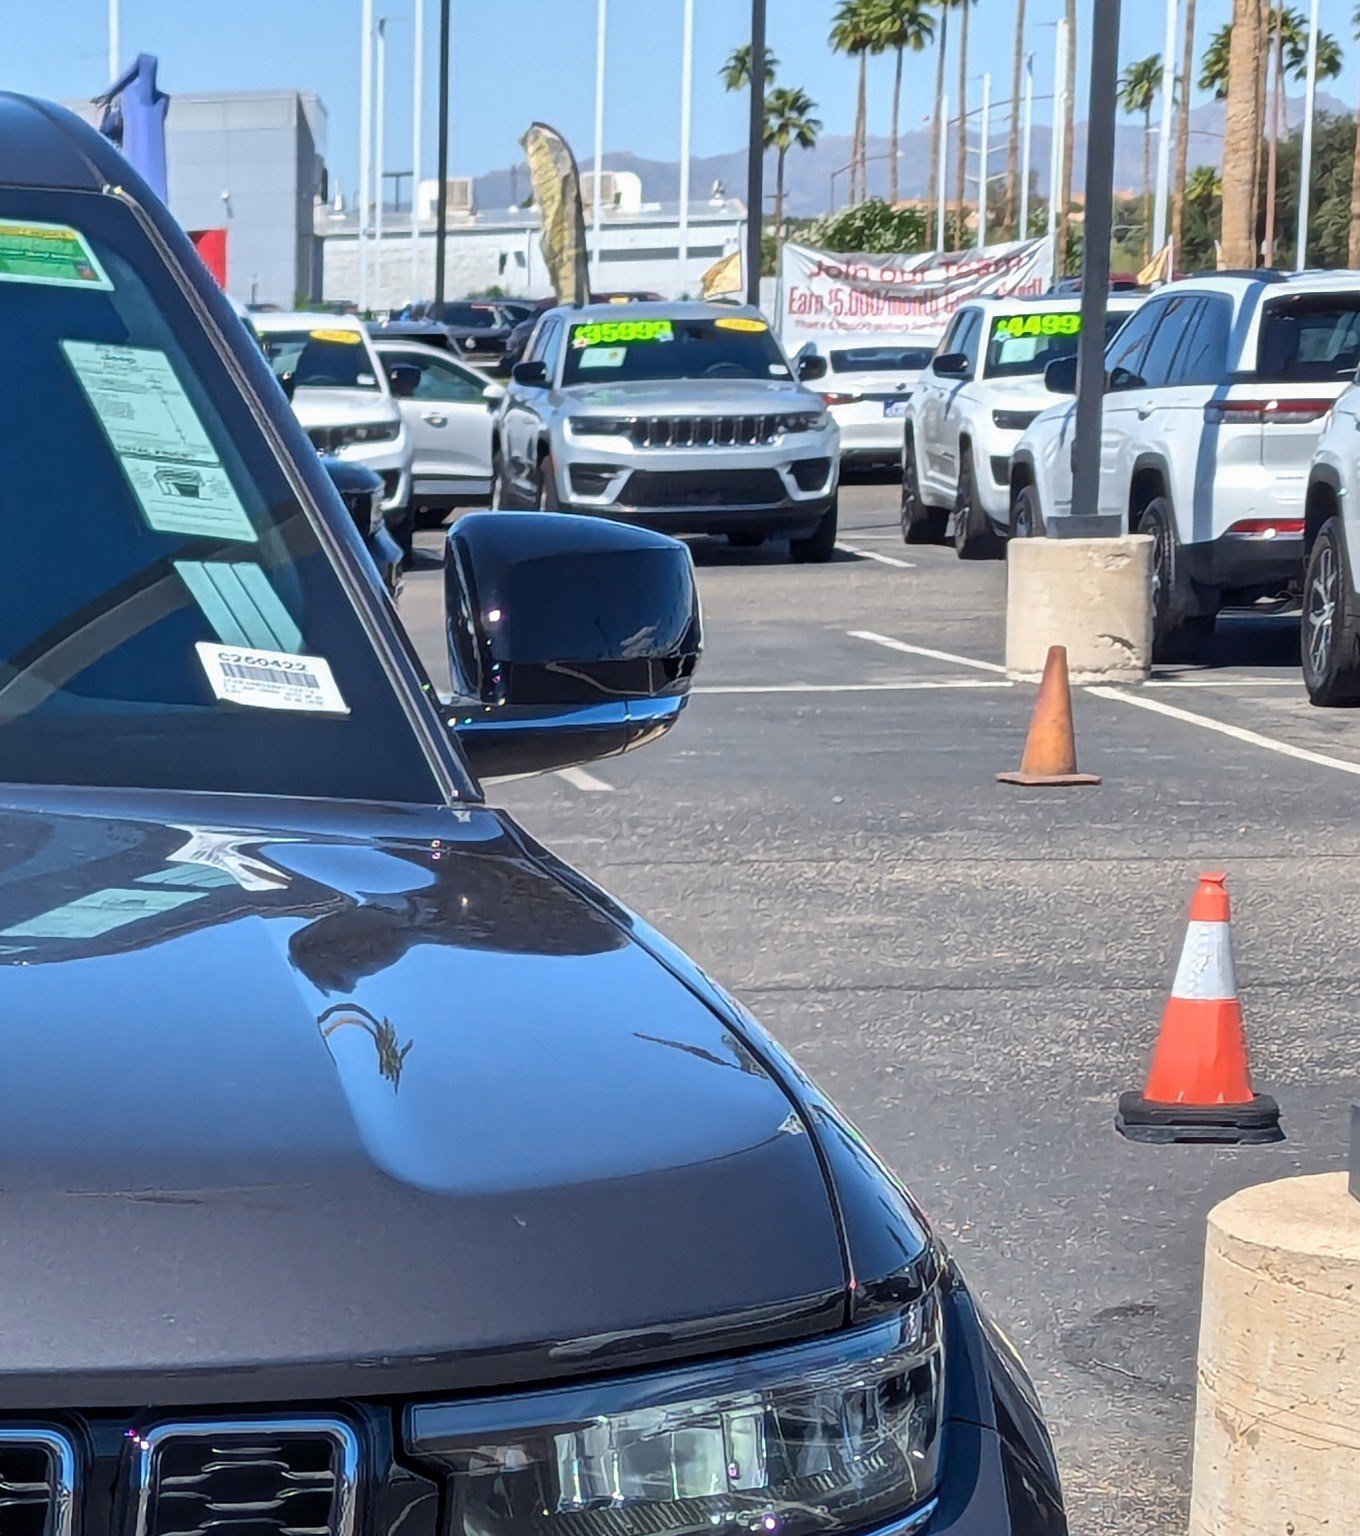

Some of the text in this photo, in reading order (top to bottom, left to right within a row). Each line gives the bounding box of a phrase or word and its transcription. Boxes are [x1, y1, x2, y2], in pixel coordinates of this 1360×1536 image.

[809, 260, 870, 281] Join
[881, 267, 925, 284] our
[788, 286, 823, 315] Earn
